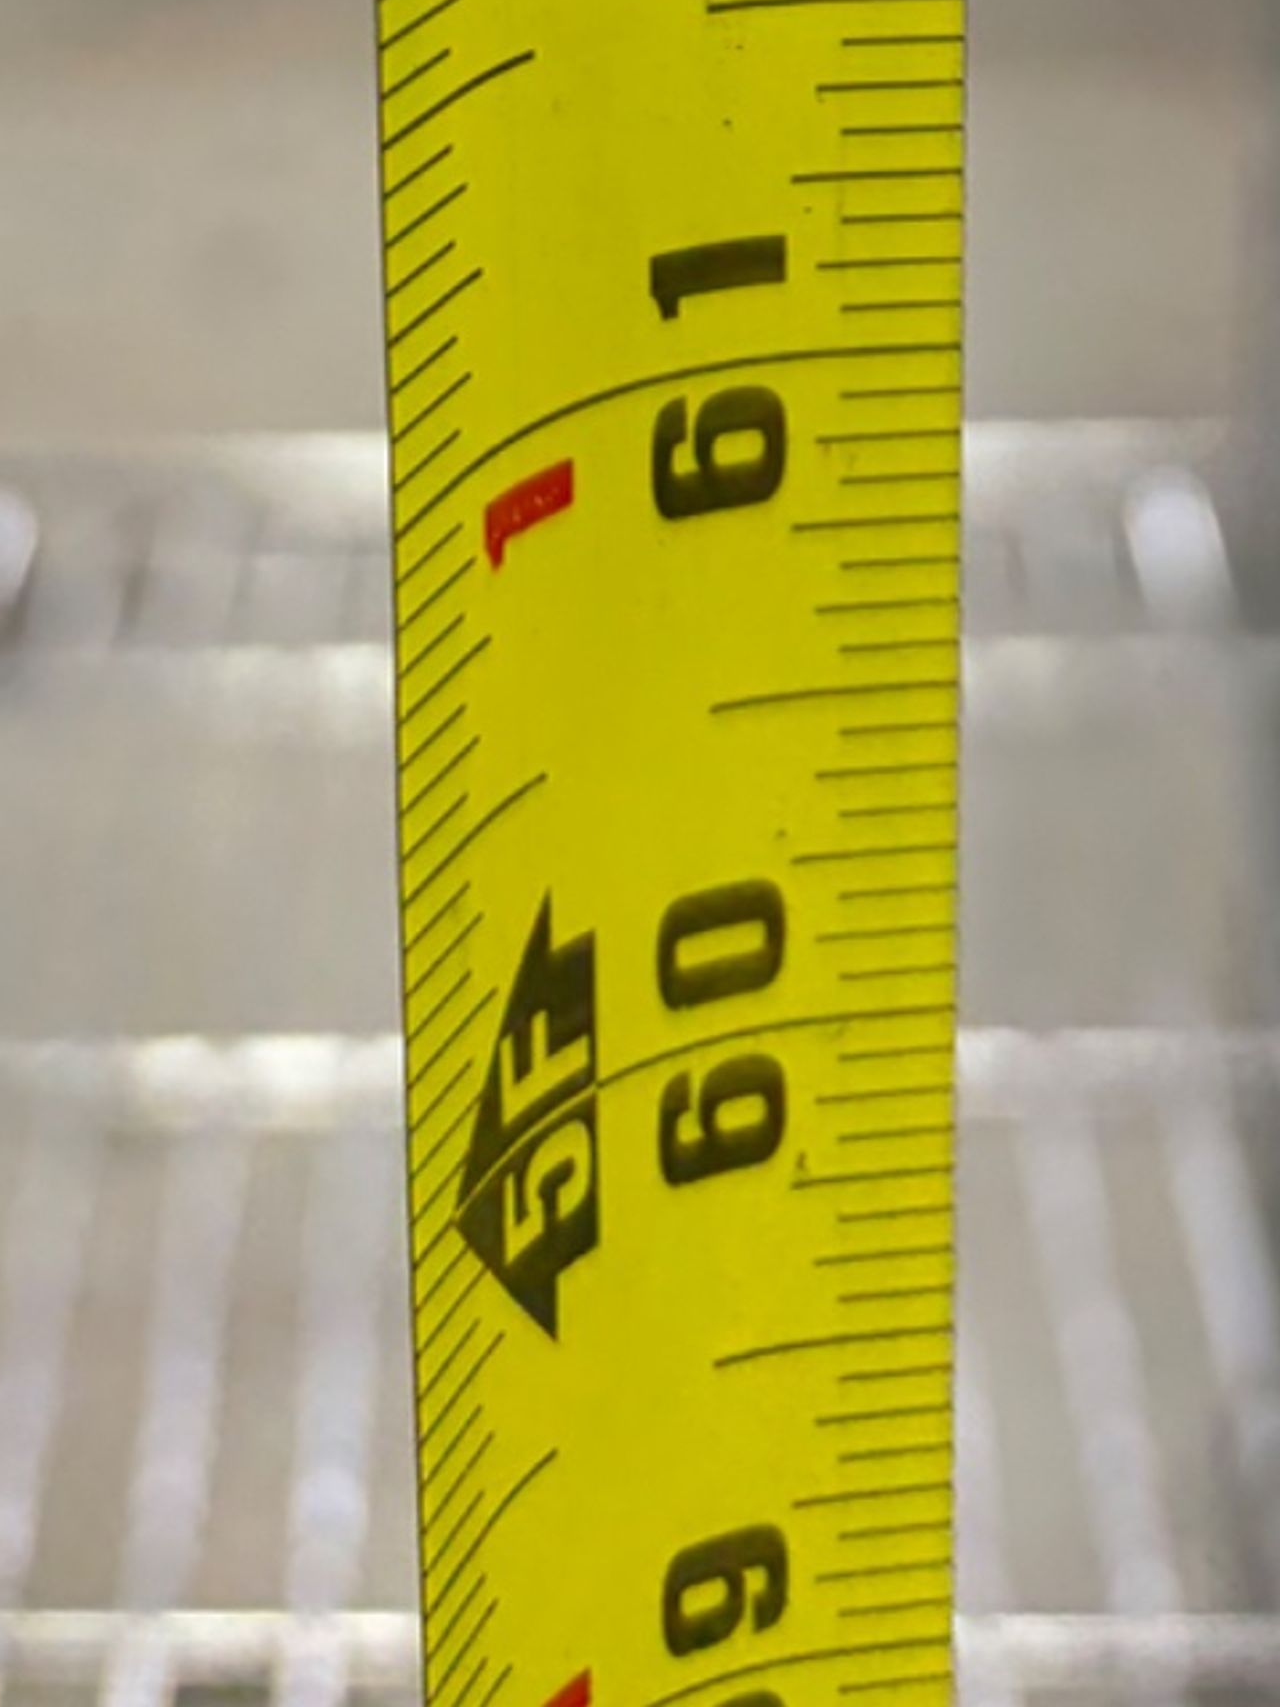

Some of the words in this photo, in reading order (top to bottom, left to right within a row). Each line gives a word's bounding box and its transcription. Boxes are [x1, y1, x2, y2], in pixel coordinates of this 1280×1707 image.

[649, 235, 787, 521] 61
[483, 457, 574, 572] 1
[501, 1008, 594, 1268] 5F
[656, 877, 787, 1188] 60
[662, 1523, 790, 1707] 9
